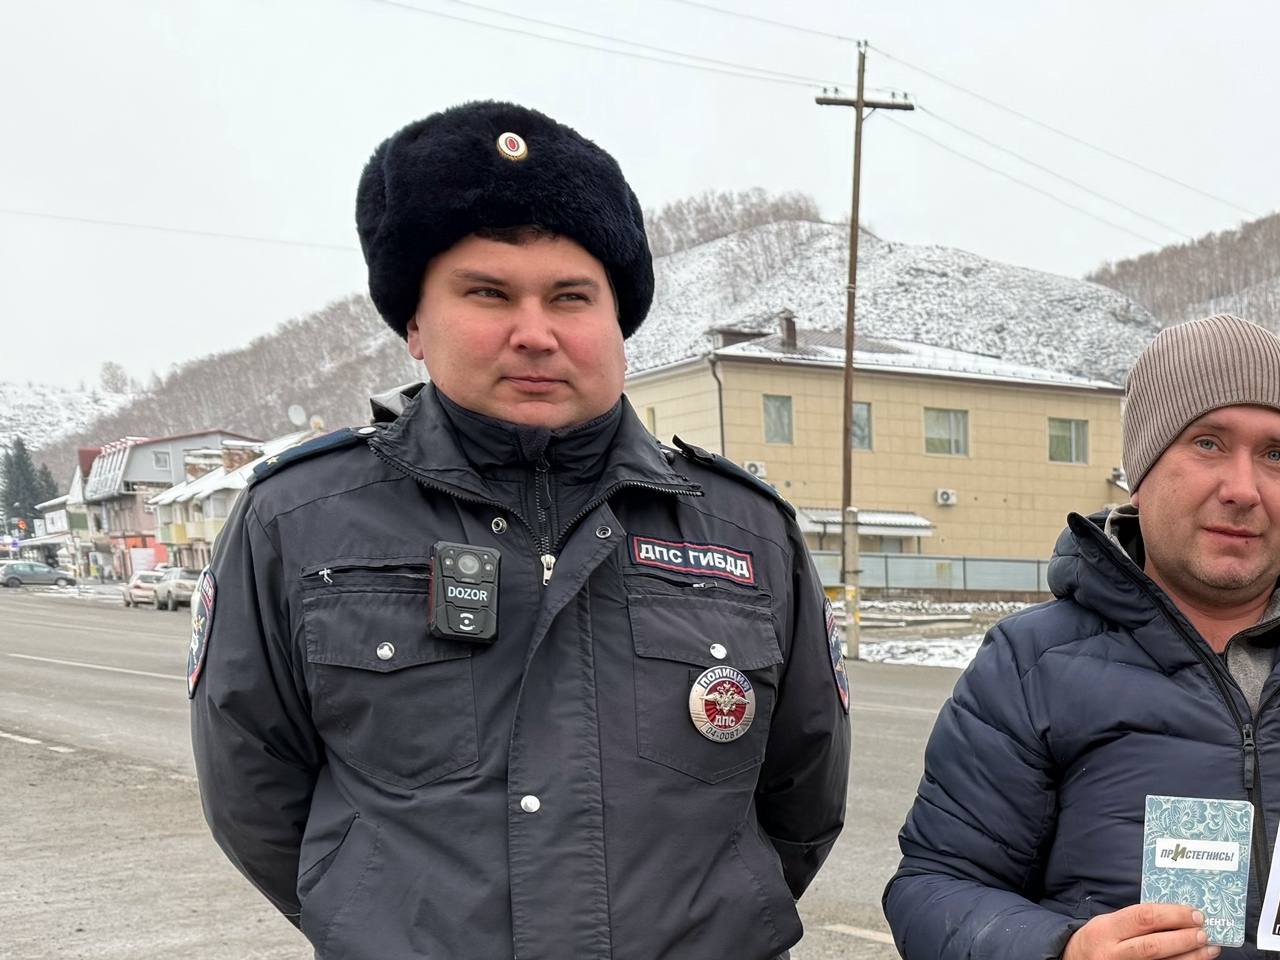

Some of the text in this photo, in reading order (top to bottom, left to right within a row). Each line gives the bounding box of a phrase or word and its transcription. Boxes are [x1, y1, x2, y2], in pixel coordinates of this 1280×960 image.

[639, 543, 750, 578] ДПС ГИБДД
[448, 586, 487, 601] DOZOR
[700, 669, 750, 690] ПОЛИЦИЯ
[714, 715, 736, 727] ДПС
[1160, 843, 1235, 862] ПРИСТЕГНИСЬ!
